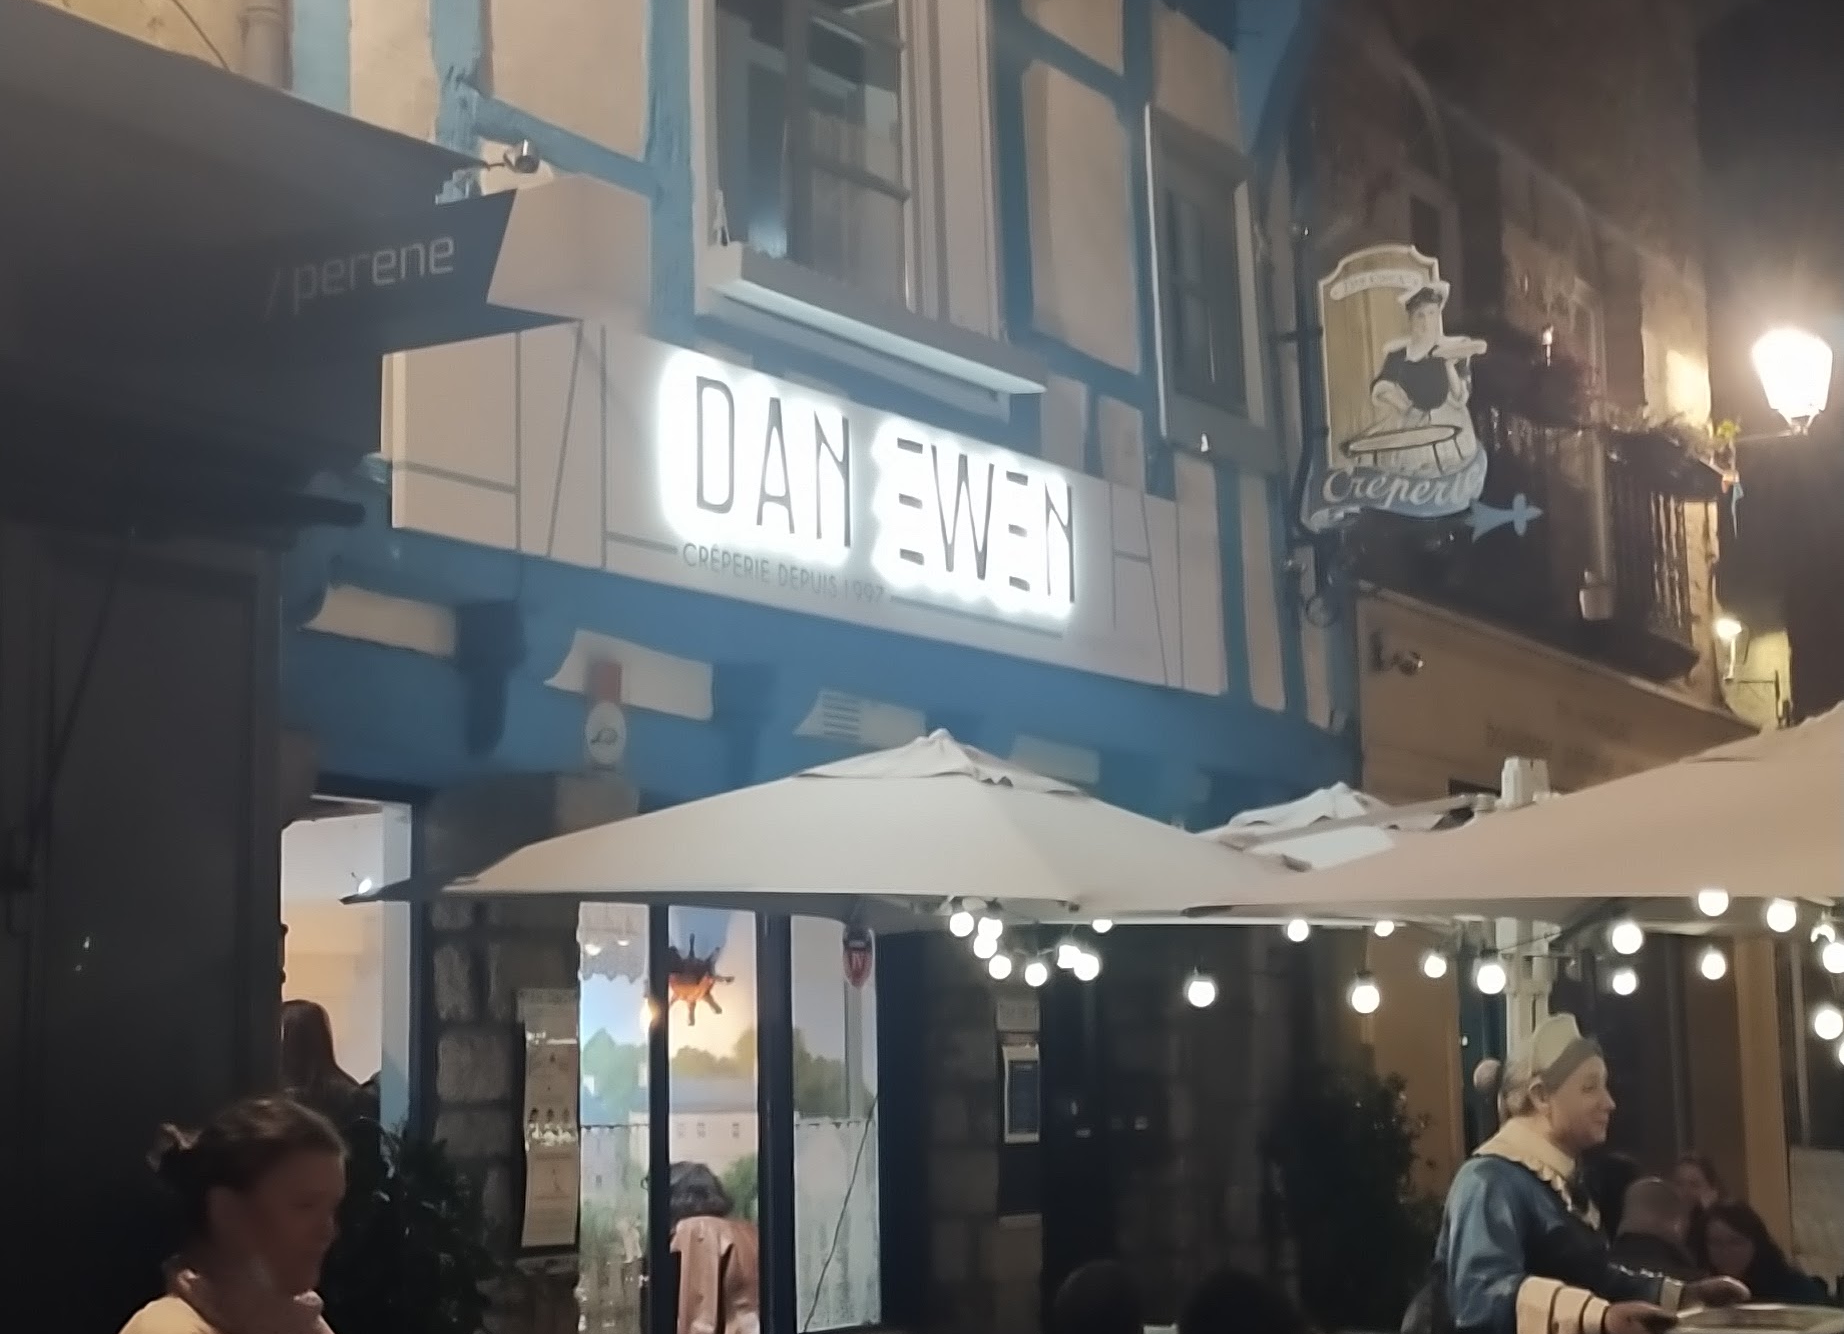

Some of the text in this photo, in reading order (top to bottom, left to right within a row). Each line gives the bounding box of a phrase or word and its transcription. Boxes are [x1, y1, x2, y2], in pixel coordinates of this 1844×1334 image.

[695, 374, 1077, 604] DAN EWEN
[777, 562, 838, 598] DEPUIS
